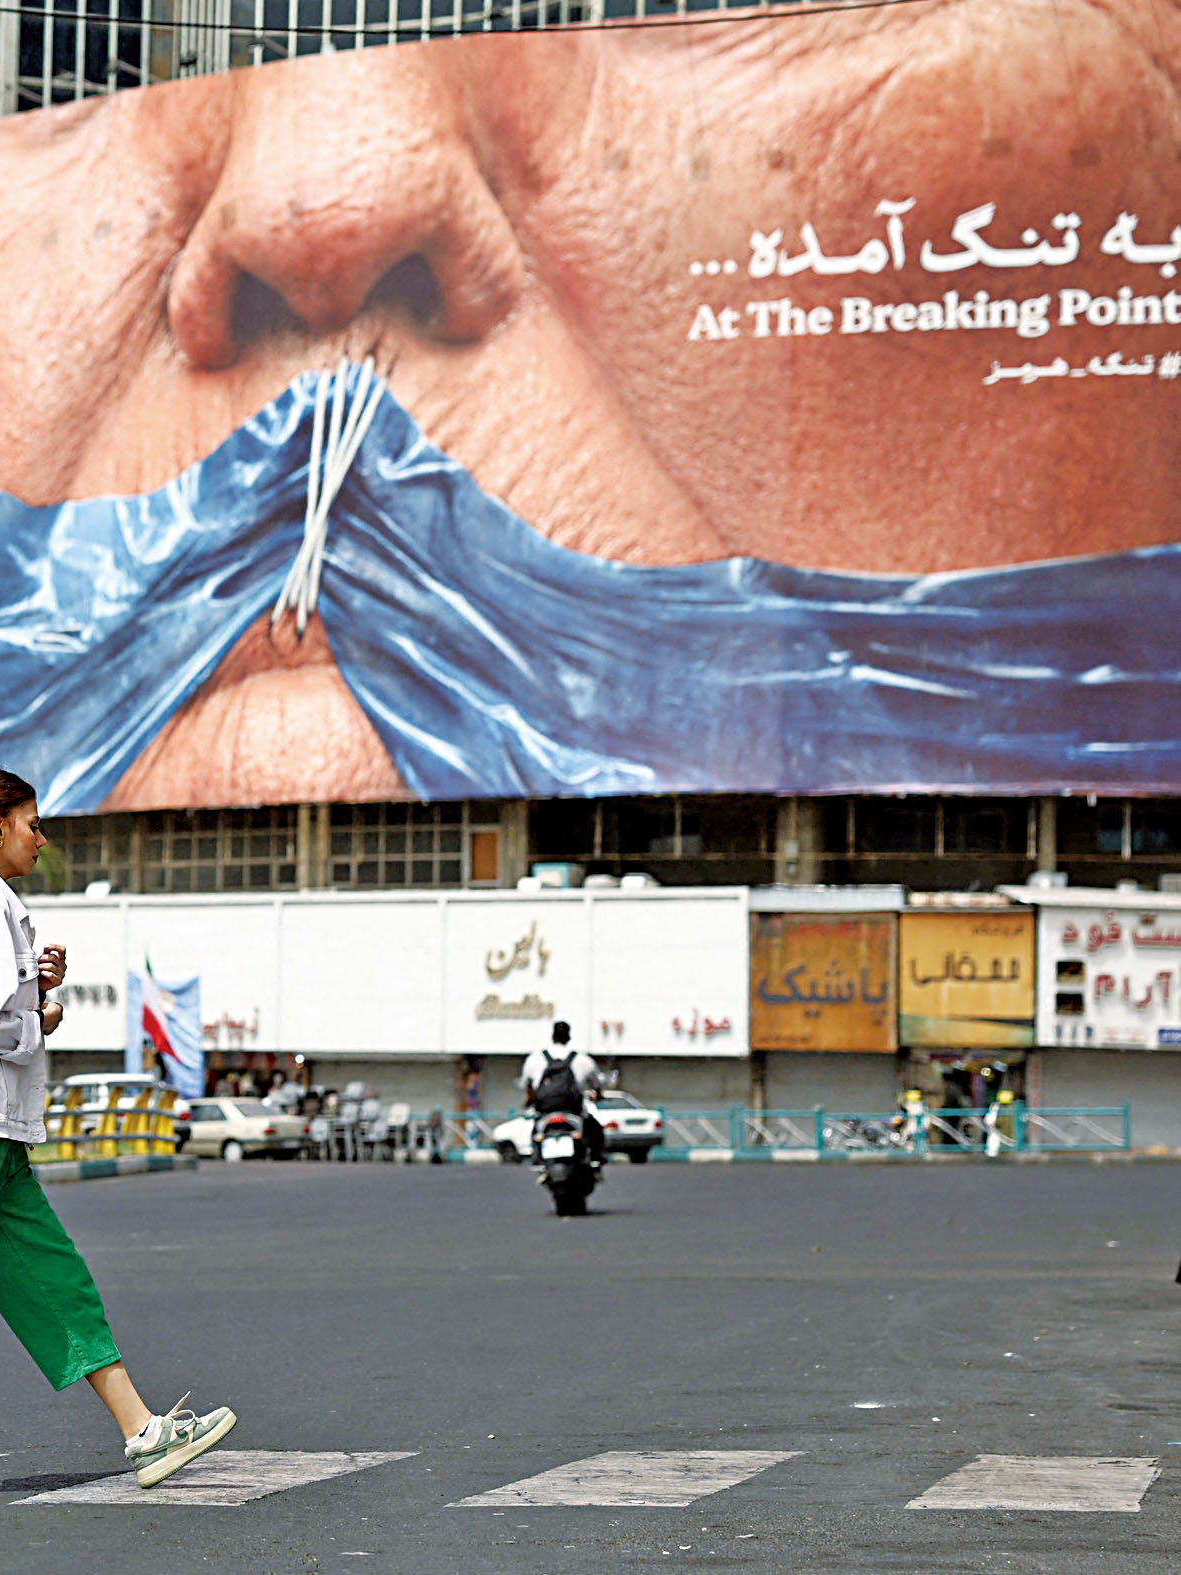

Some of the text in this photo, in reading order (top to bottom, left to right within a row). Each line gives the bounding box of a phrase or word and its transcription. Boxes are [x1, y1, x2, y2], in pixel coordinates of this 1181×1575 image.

[748, 197, 916, 278] آمده
[1101, 212, 1181, 278] به
[687, 286, 1181, 341] At The Breaking Point
[1131, 912, 1181, 947] ست
[1095, 971, 1173, 1009] آرام
